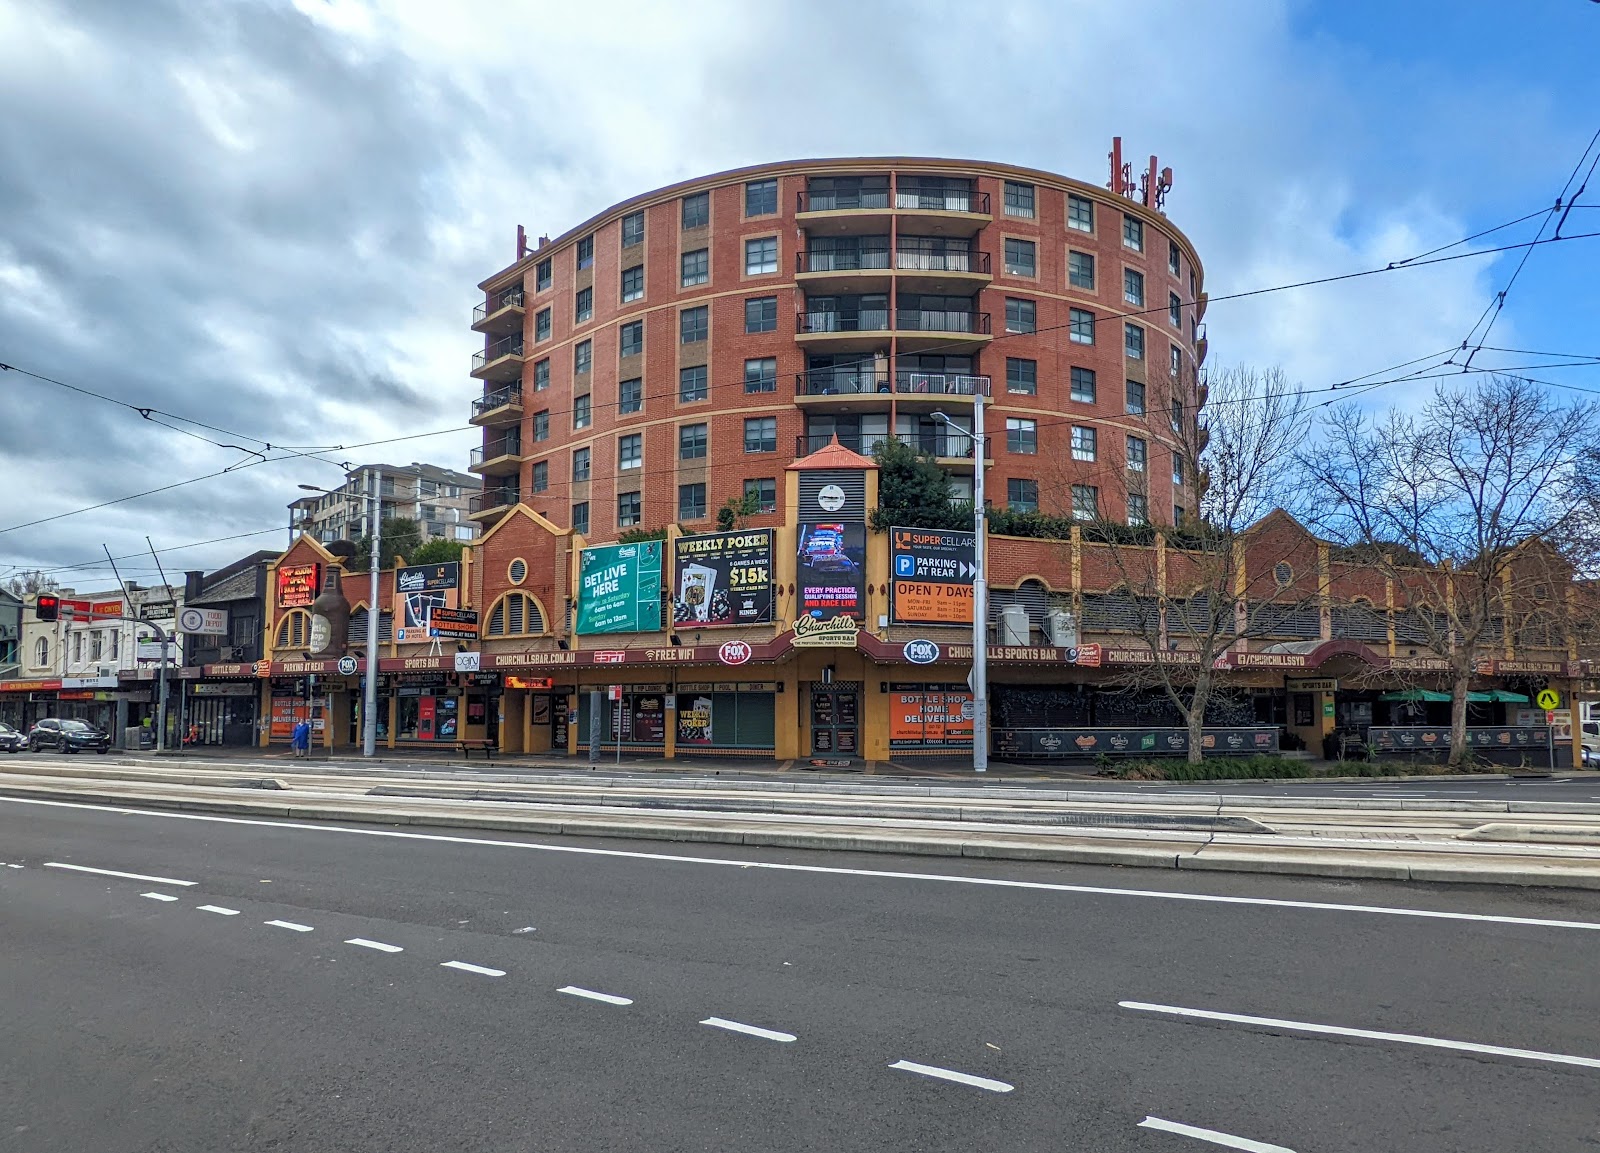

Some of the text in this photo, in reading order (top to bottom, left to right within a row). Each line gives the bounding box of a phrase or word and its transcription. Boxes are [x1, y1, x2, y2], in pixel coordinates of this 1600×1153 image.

[678, 534, 769, 553] WEEKLY POKER
[912, 534, 976, 547] SUPERCELLARS
[900, 559, 910, 572] P
[917, 558, 957, 568] PARKING
[584, 564, 627, 588] BET LIVE
[917, 567, 955, 577] AT REAR
[290, 576, 306, 584] OPEN
[592, 579, 619, 598] HERE
[898, 584, 974, 598] OPEN 7 DAYS
[607, 592, 630, 603] Saturday
[442, 610, 476, 619] SUPERCELLARS
[588, 613, 607, 623] Sunday
[434, 621, 455, 629] BOTTLE
[794, 615, 854, 636] Churchills
[725, 645, 745, 656] FOX
[911, 644, 932, 653] FOX
[948, 646, 1057, 660] CHURLLS SPORTS BAR
[496, 652, 576, 665] CHURCHILLSBAR.COM.AU
[594, 651, 625, 663] ESPN
[655, 648, 695, 661] FREE WIFI
[283, 662, 325, 673] PARKING AT REAR
[341, 660, 354, 668] FOX
[405, 658, 440, 669] SPORTS BAR
[211, 665, 241, 675] BOTTLE SHOP
[941, 695, 967, 703] SHOP
[680, 710, 710, 719] WEEKLY
[919, 705, 950, 713] HOME
[682, 720, 708, 728] POKER
